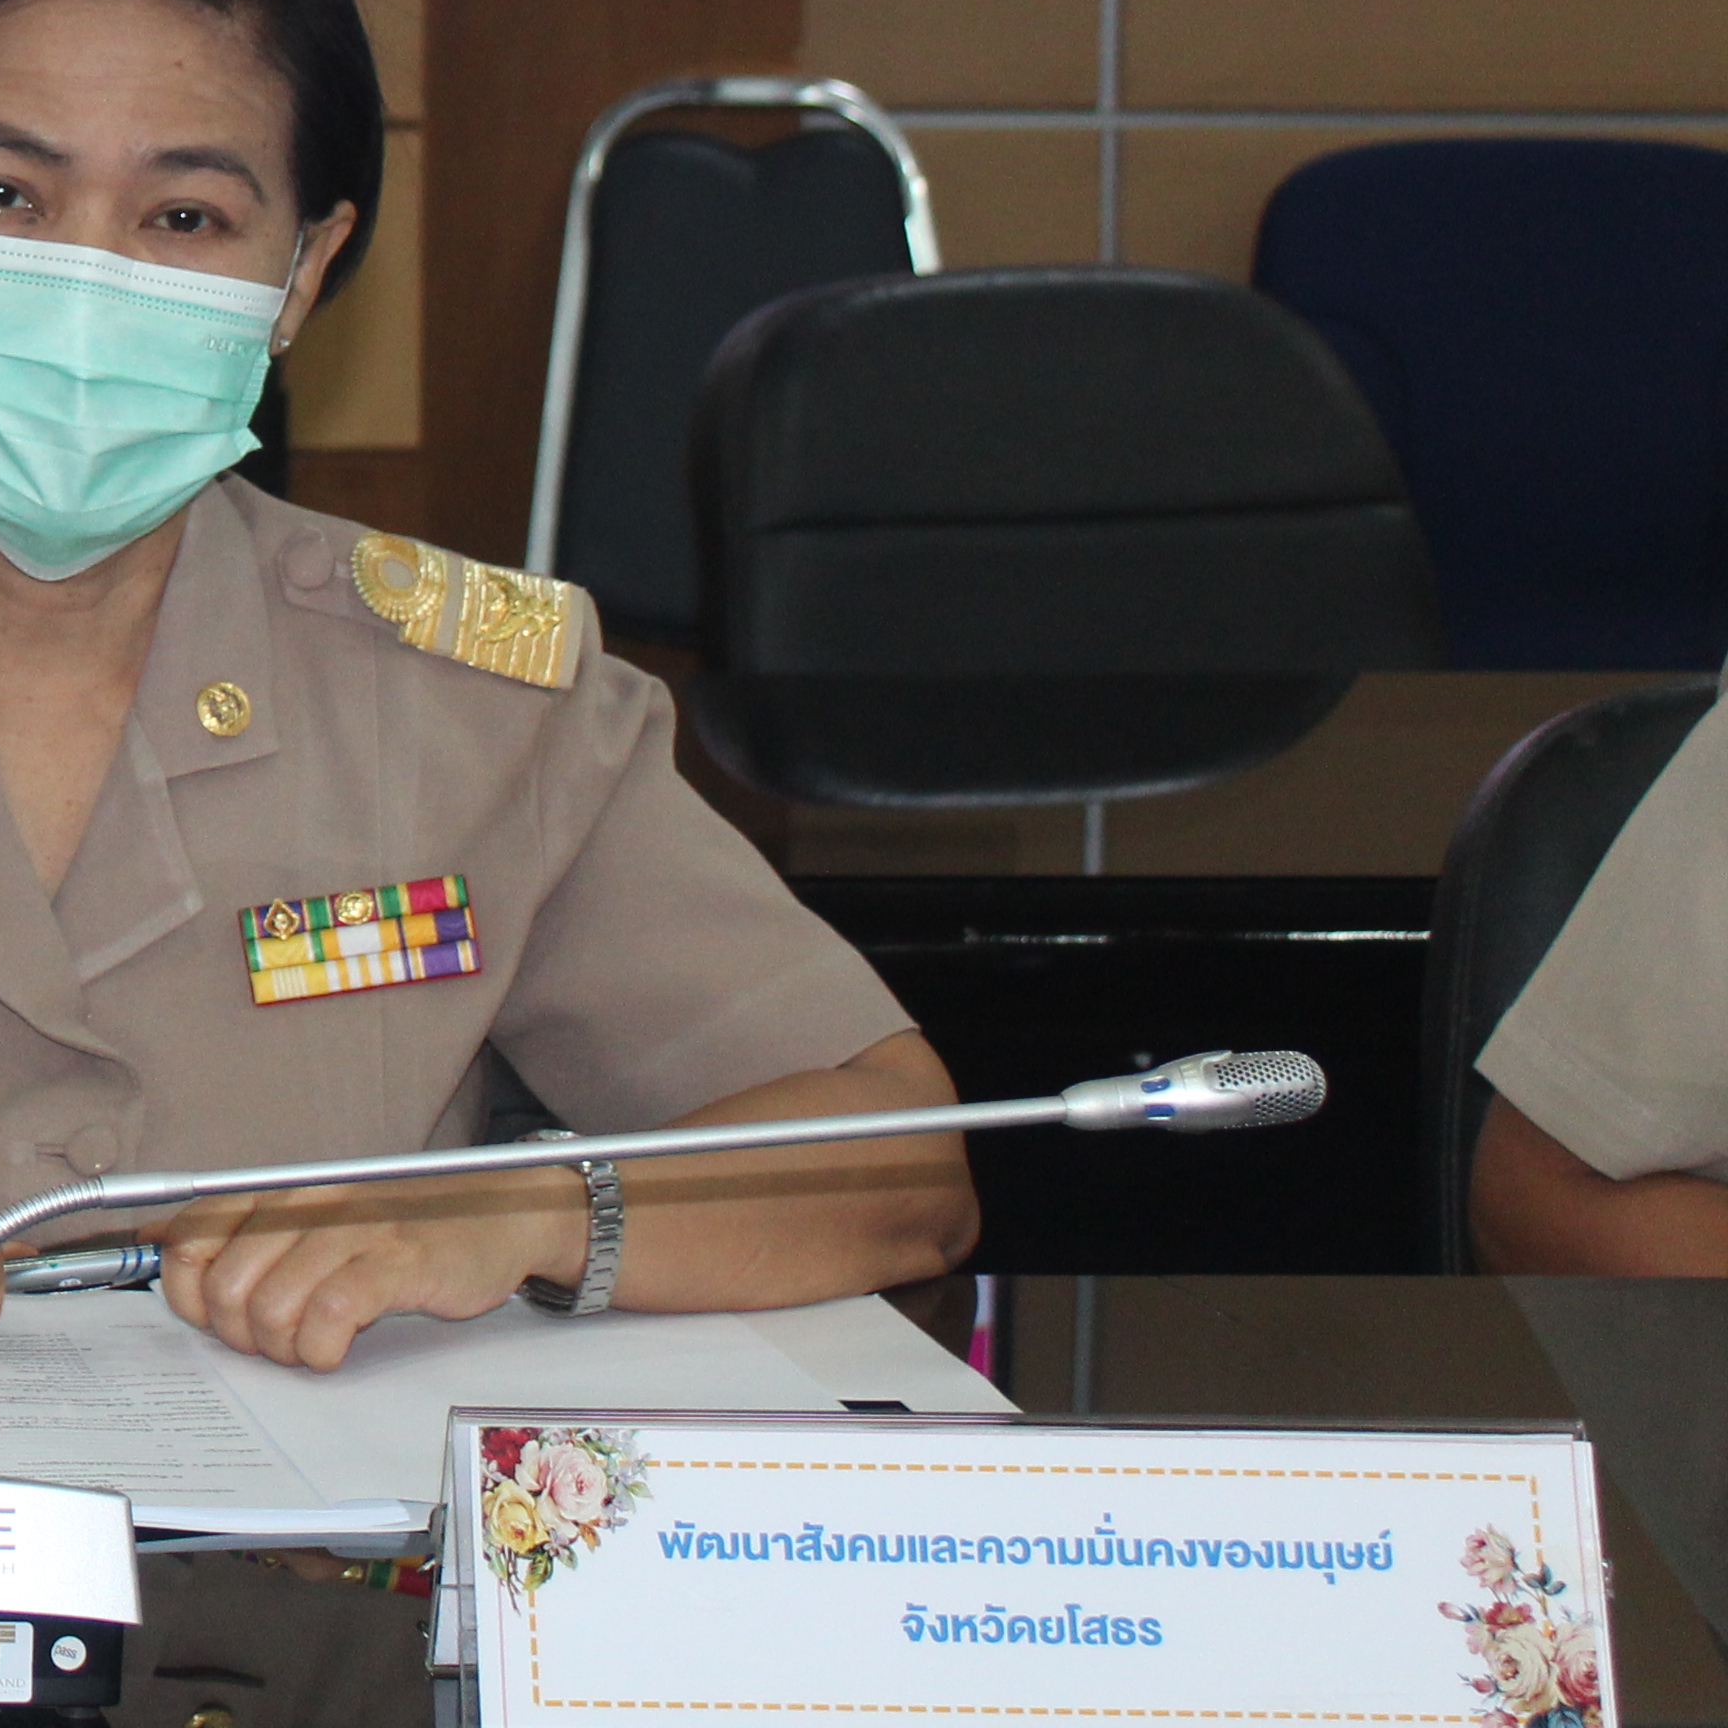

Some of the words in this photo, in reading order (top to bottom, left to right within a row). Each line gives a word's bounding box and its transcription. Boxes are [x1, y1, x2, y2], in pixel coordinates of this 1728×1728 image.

[657, 1510, 1397, 1589] พัฒนาสังคมและความมั่นคงของมนุษย์
[901, 1602, 1166, 1650] จังหวัดยโสธร
[54, 1644, 78, 1660] pass
